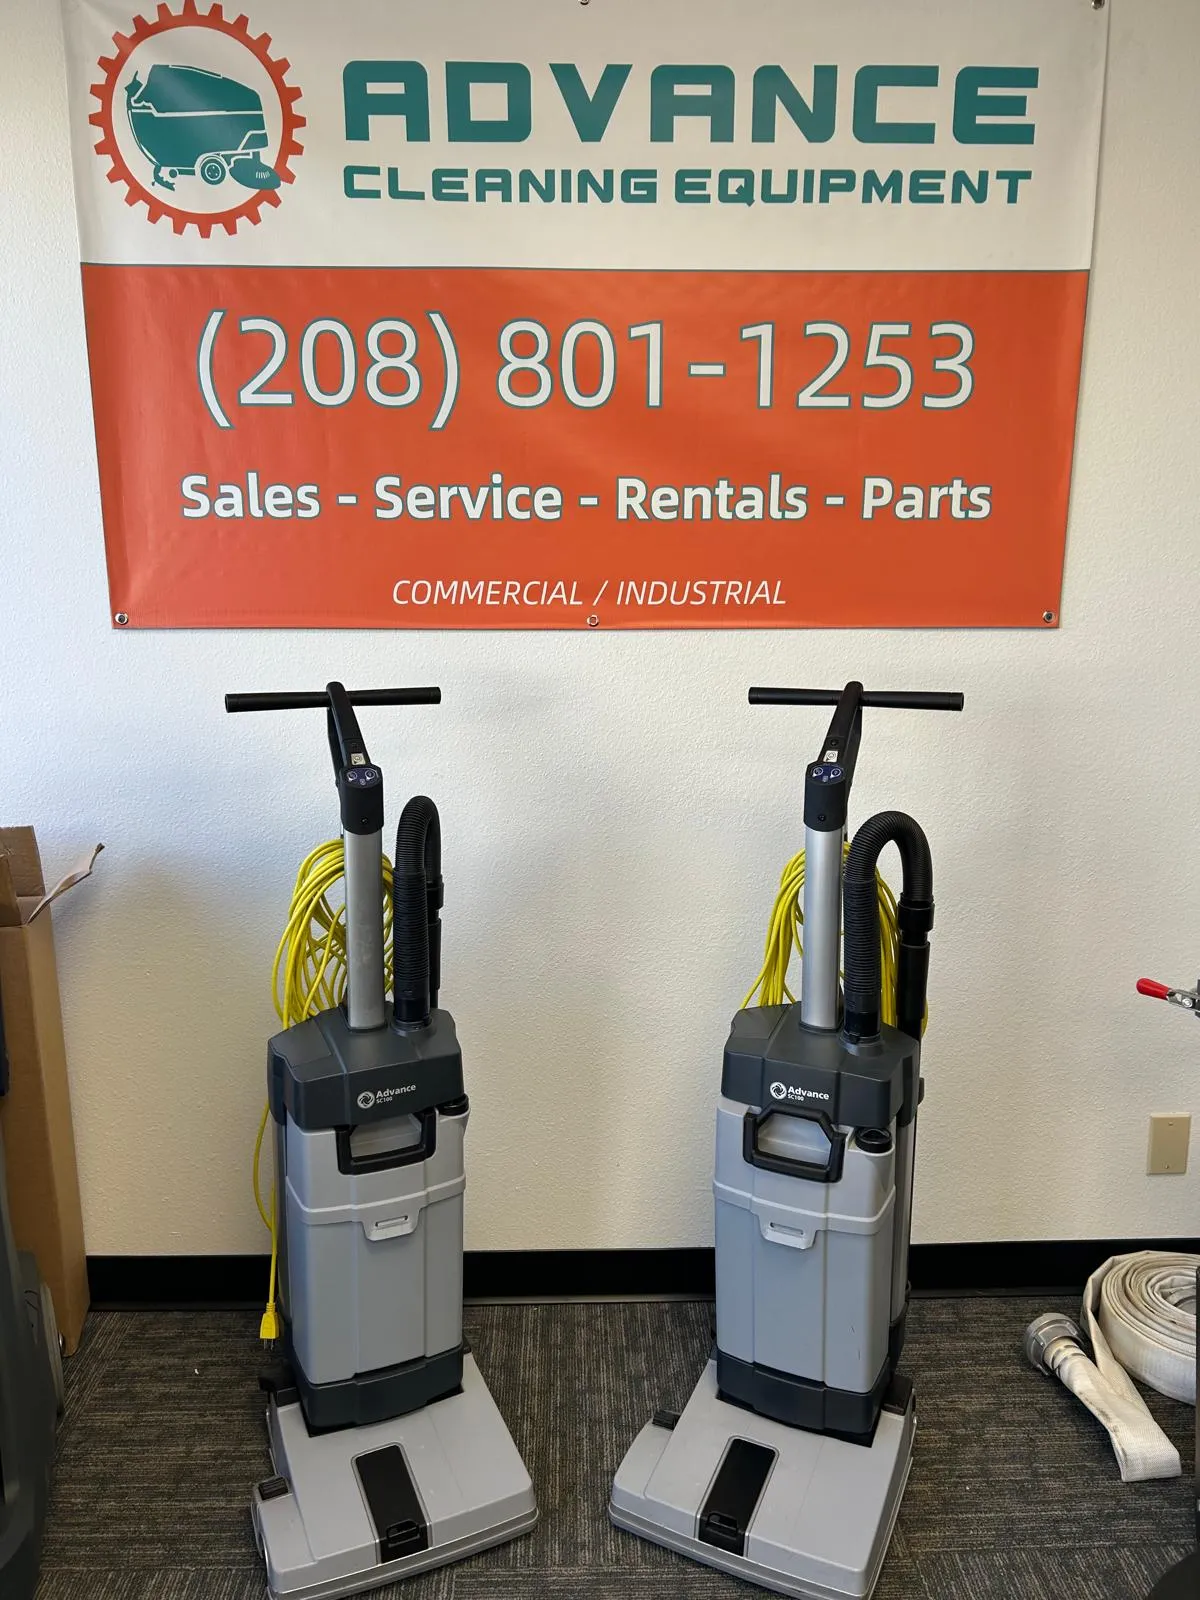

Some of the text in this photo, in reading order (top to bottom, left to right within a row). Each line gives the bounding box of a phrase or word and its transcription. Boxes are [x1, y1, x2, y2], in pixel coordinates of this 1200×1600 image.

[342, 60, 1040, 145] ADVANCE
[343, 165, 1033, 207] CLEANING EQUIPMENT
[197, 309, 977, 431] (208) 801-1253
[181, 471, 321, 520] Sales
[374, 473, 564, 521] Service
[616, 473, 809, 522] Rentals
[861, 476, 993, 520] Parts
[392, 580, 583, 606] COMMERCIAL
[616, 580, 787, 606] INDUSTRIAL
[376, 1084, 416, 1098] Advance
[788, 1086, 829, 1100] Advance
